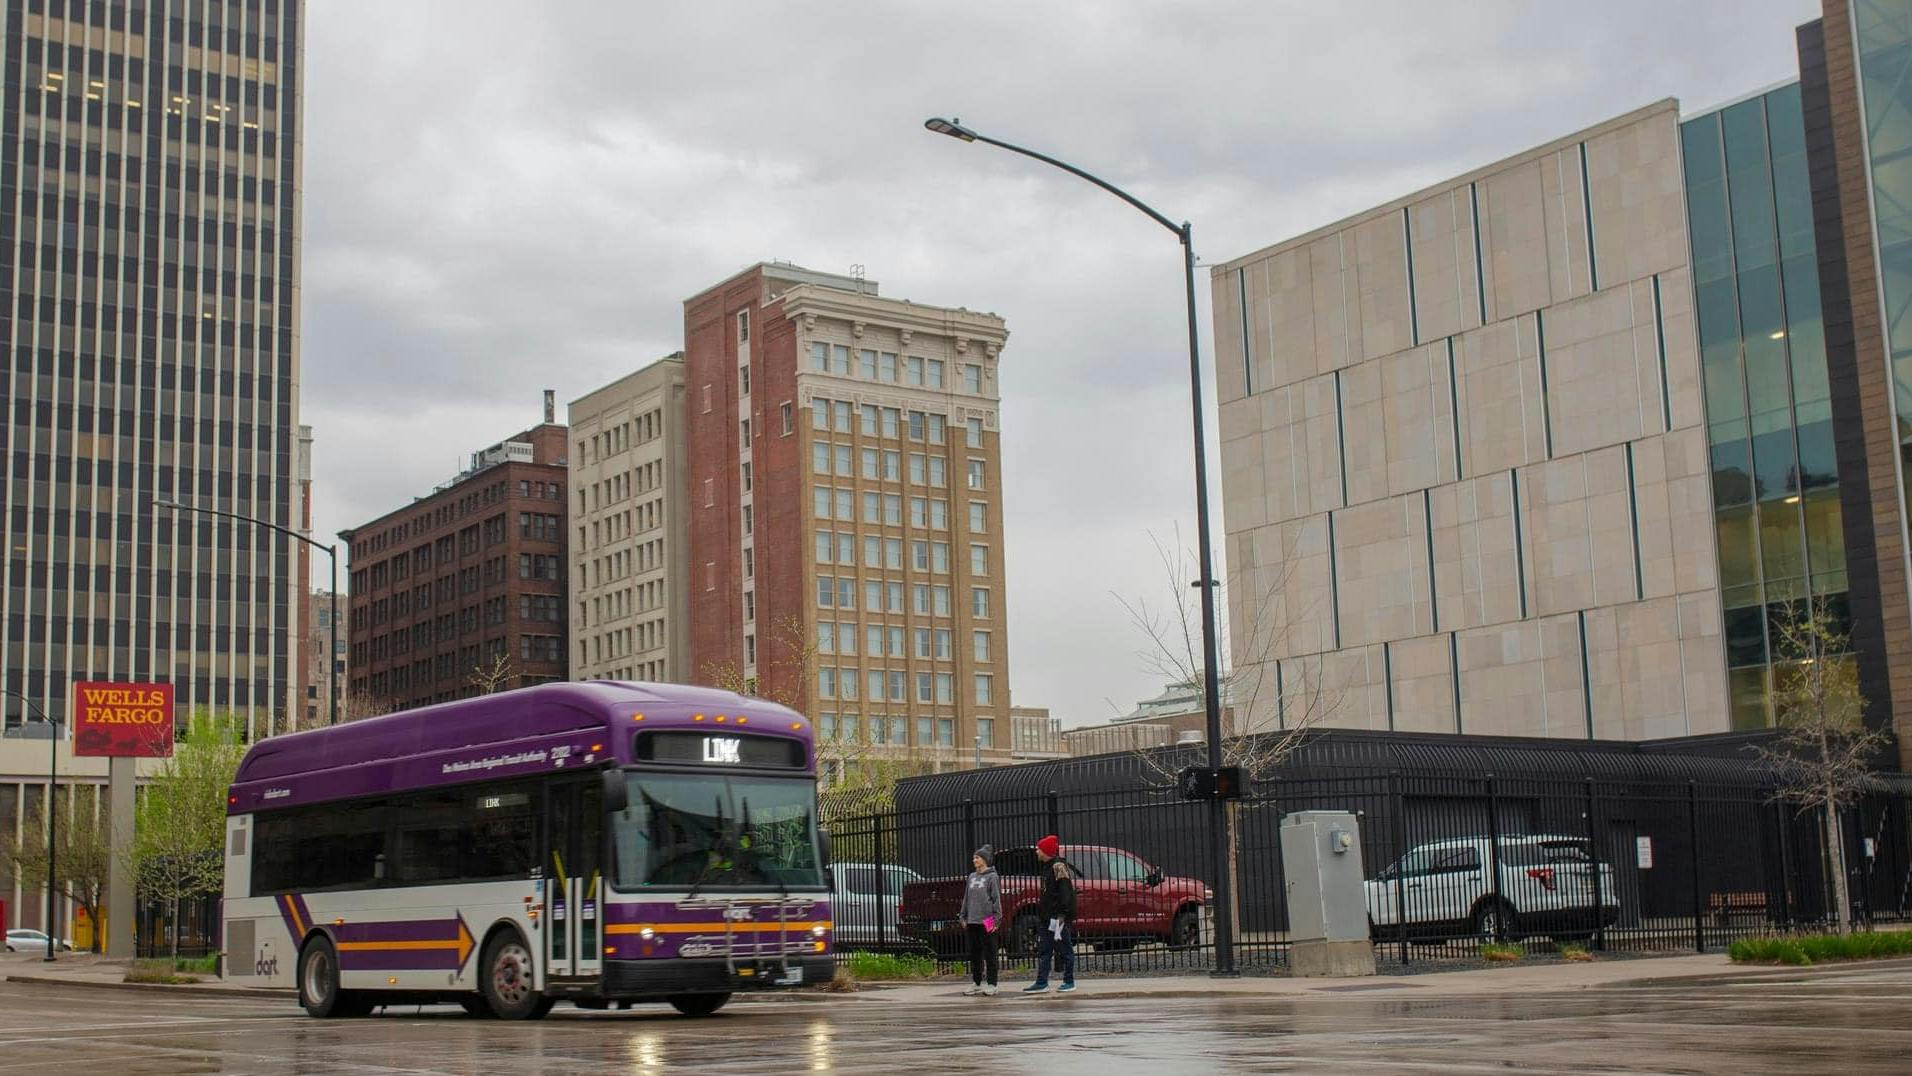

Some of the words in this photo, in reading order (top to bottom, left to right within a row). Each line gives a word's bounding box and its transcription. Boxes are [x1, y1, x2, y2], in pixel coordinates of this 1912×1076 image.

[83, 688, 164, 706] WELLS
[85, 707, 164, 724] FARGO
[703, 737, 741, 764] LINK
[255, 949, 279, 976] dart
